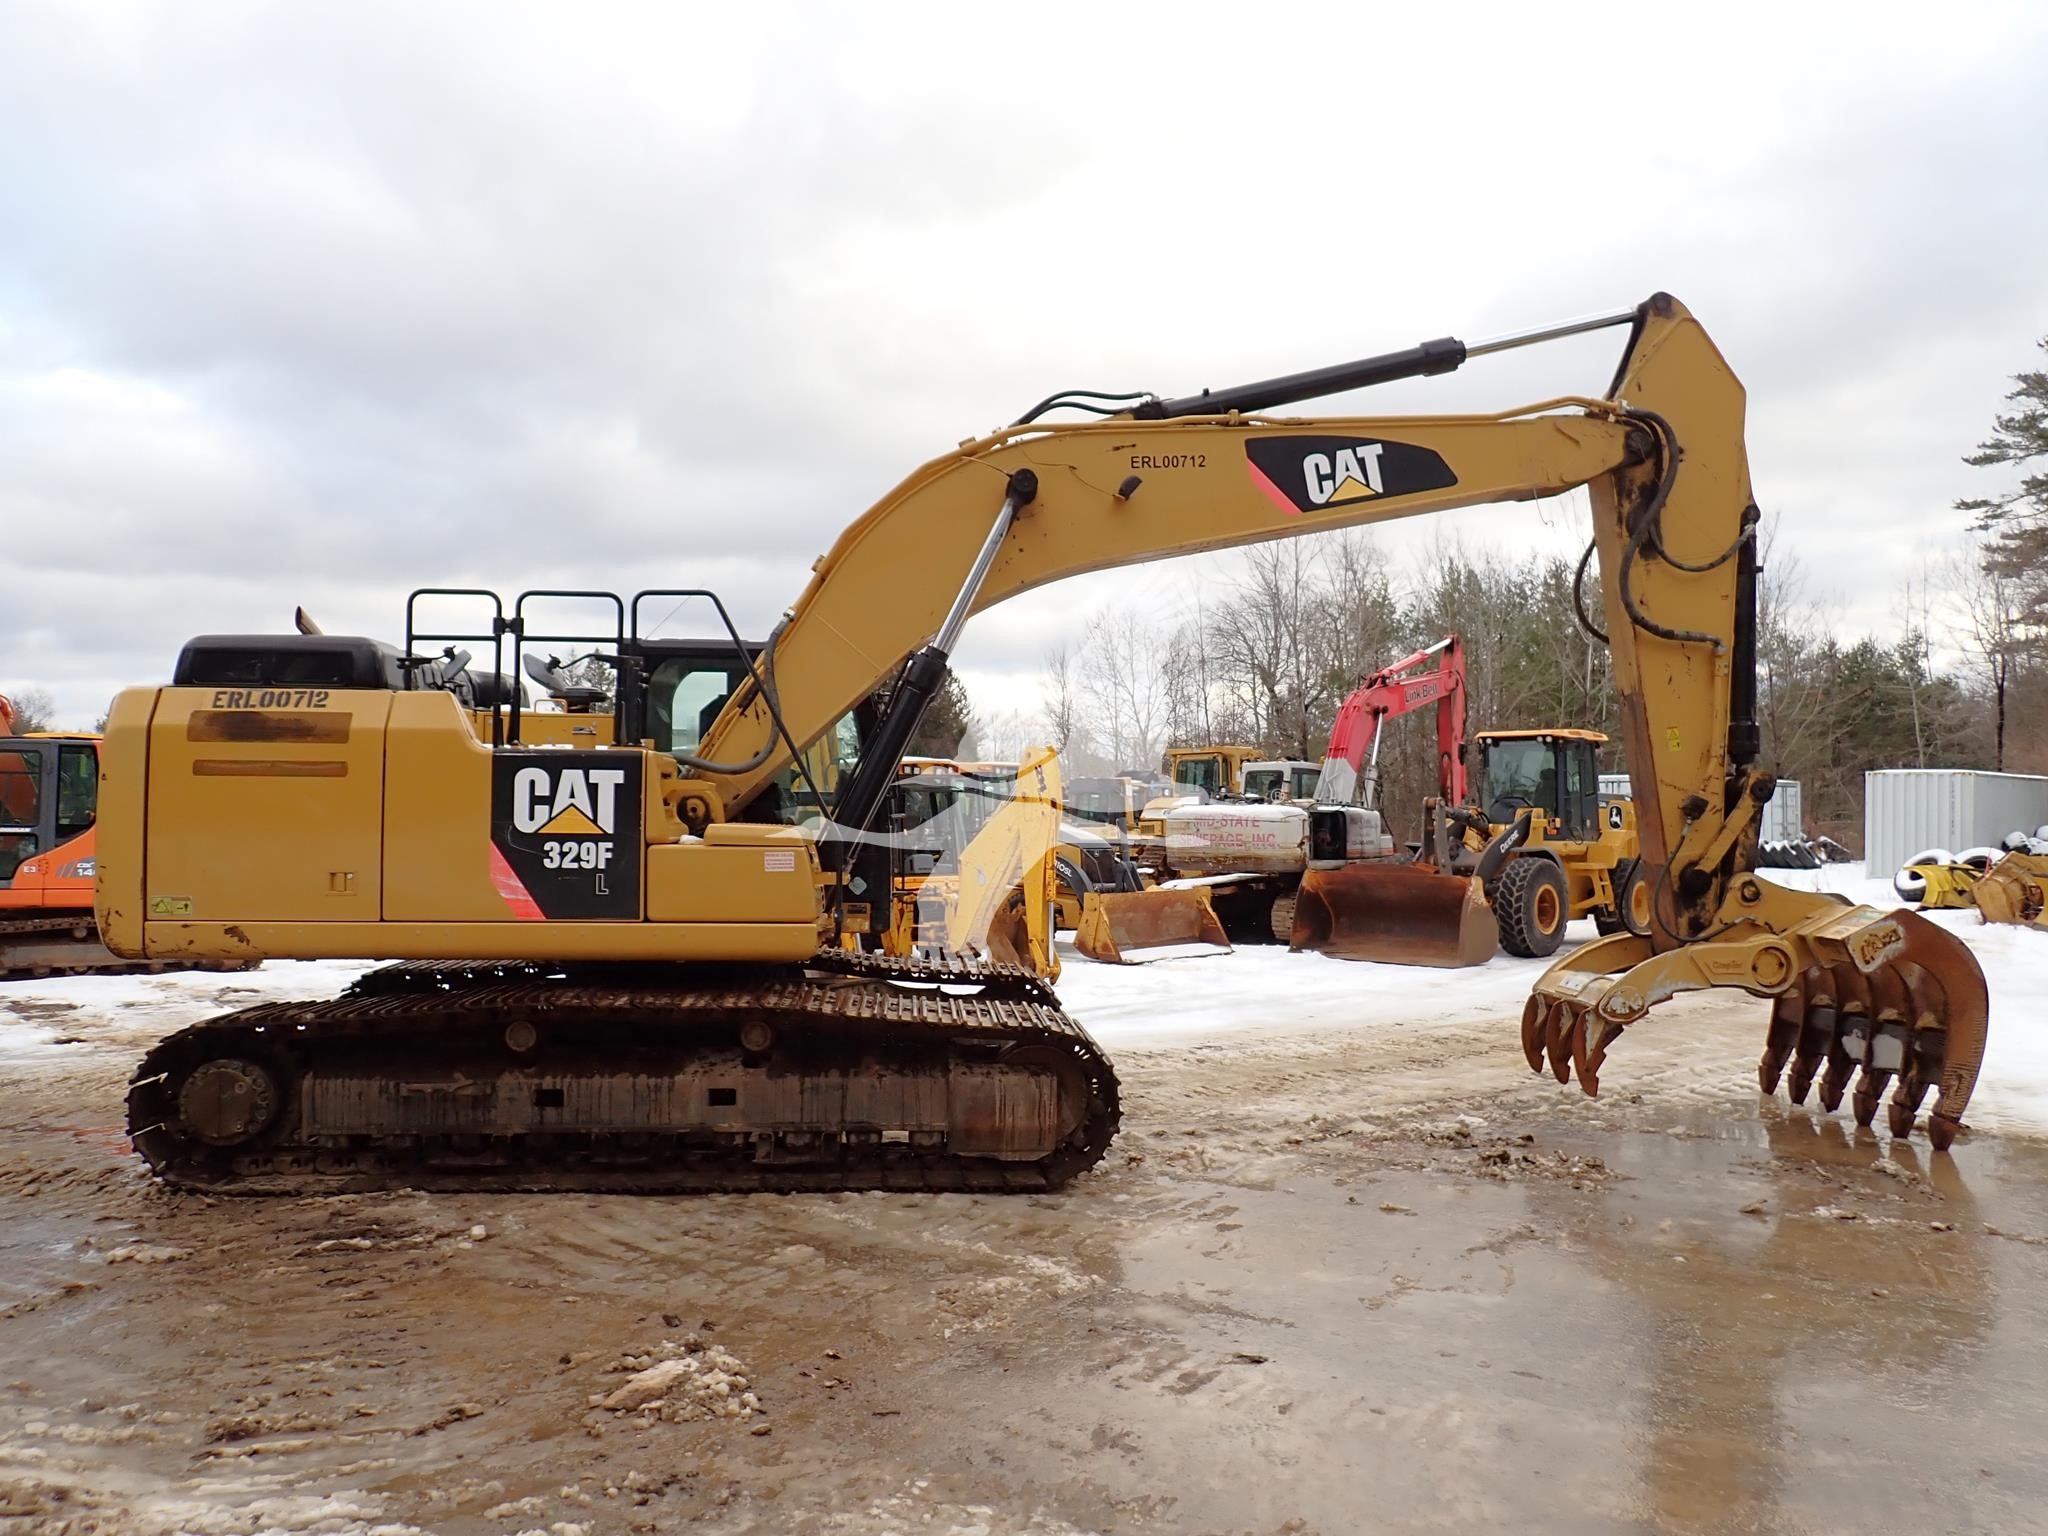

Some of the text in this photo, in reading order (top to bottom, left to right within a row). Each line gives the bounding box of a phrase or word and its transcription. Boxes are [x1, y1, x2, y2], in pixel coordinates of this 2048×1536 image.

[1130, 455, 1206, 468] ERL00712
[1303, 443, 1383, 504] CAT
[212, 691, 329, 708] ERL00712
[513, 767, 625, 834] CAT
[1500, 830, 1520, 853] DEERE
[543, 841, 613, 869] 329F
[595, 873, 609, 895] L
